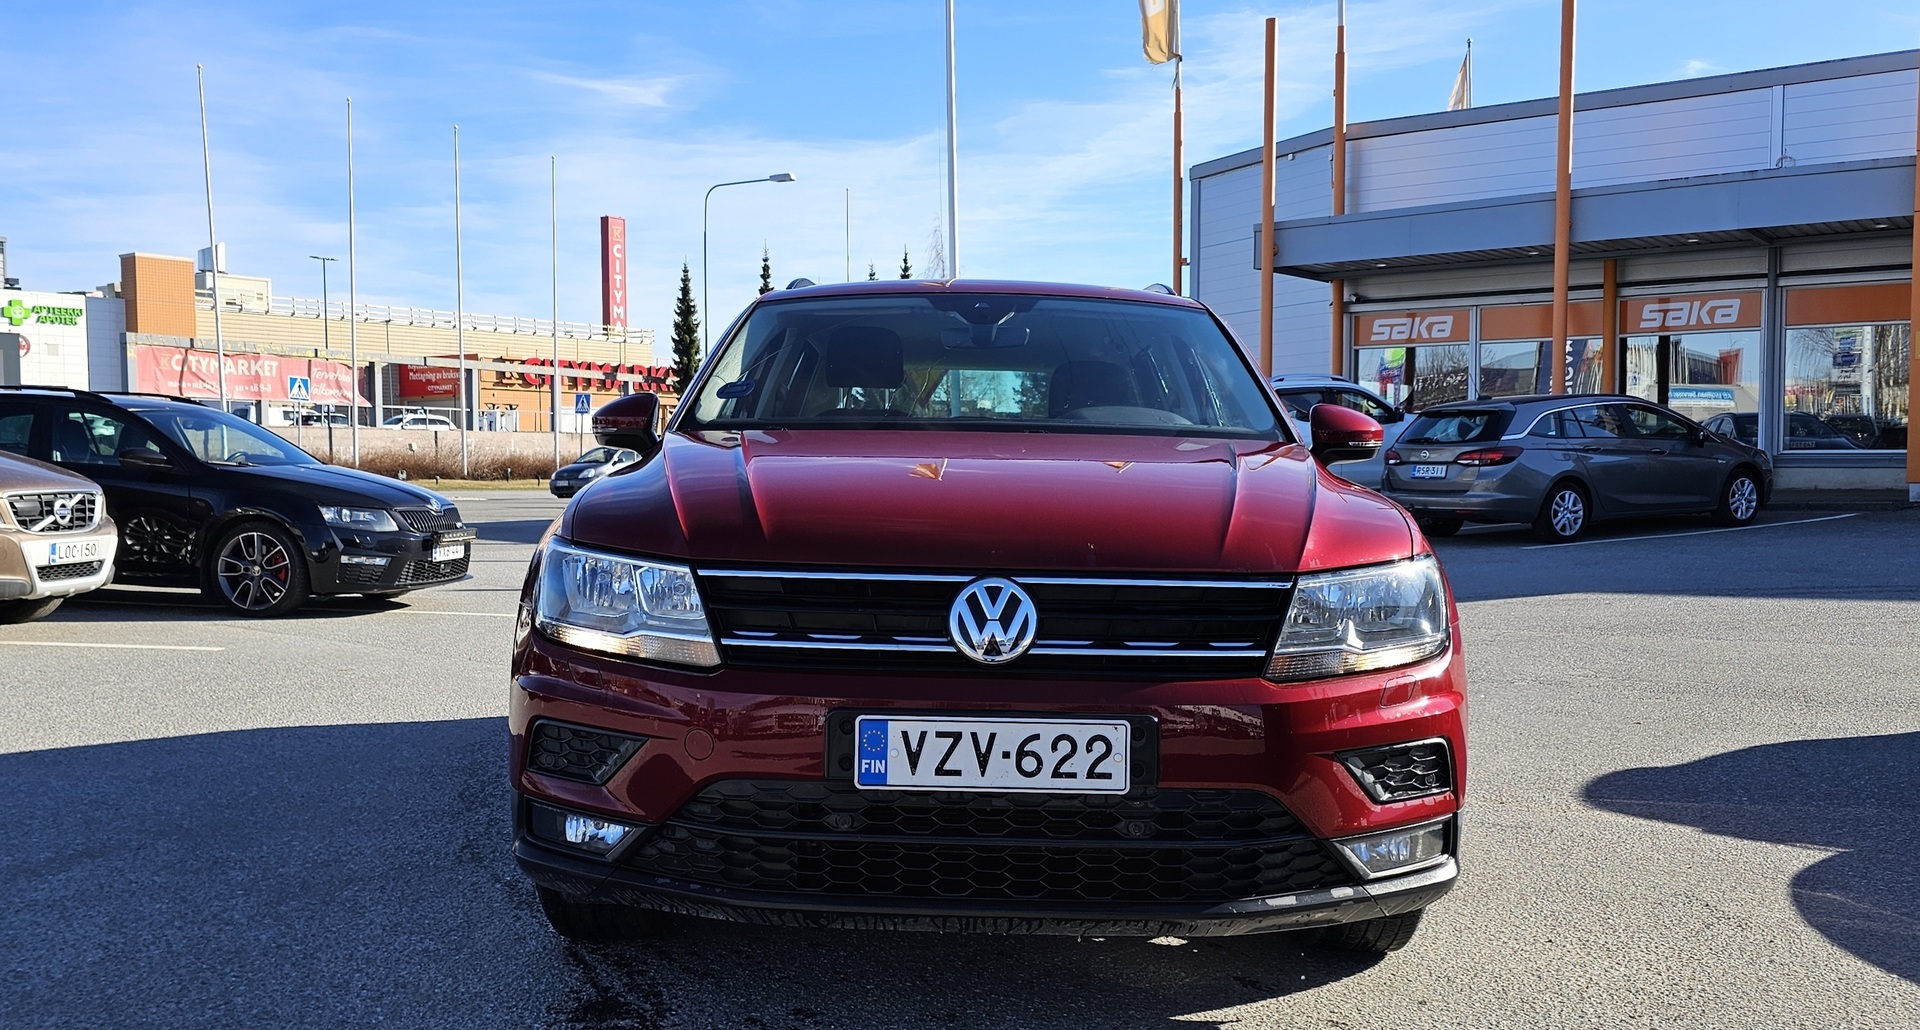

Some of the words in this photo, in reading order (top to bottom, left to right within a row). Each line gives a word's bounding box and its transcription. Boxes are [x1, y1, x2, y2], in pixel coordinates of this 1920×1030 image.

[32, 306, 83, 317] APTEEKKI
[36, 315, 78, 326] APOTEK
[58, 542, 97, 560] LOC-150
[900, 729, 1113, 780] VZV-622
[860, 759, 886, 774] FIN
